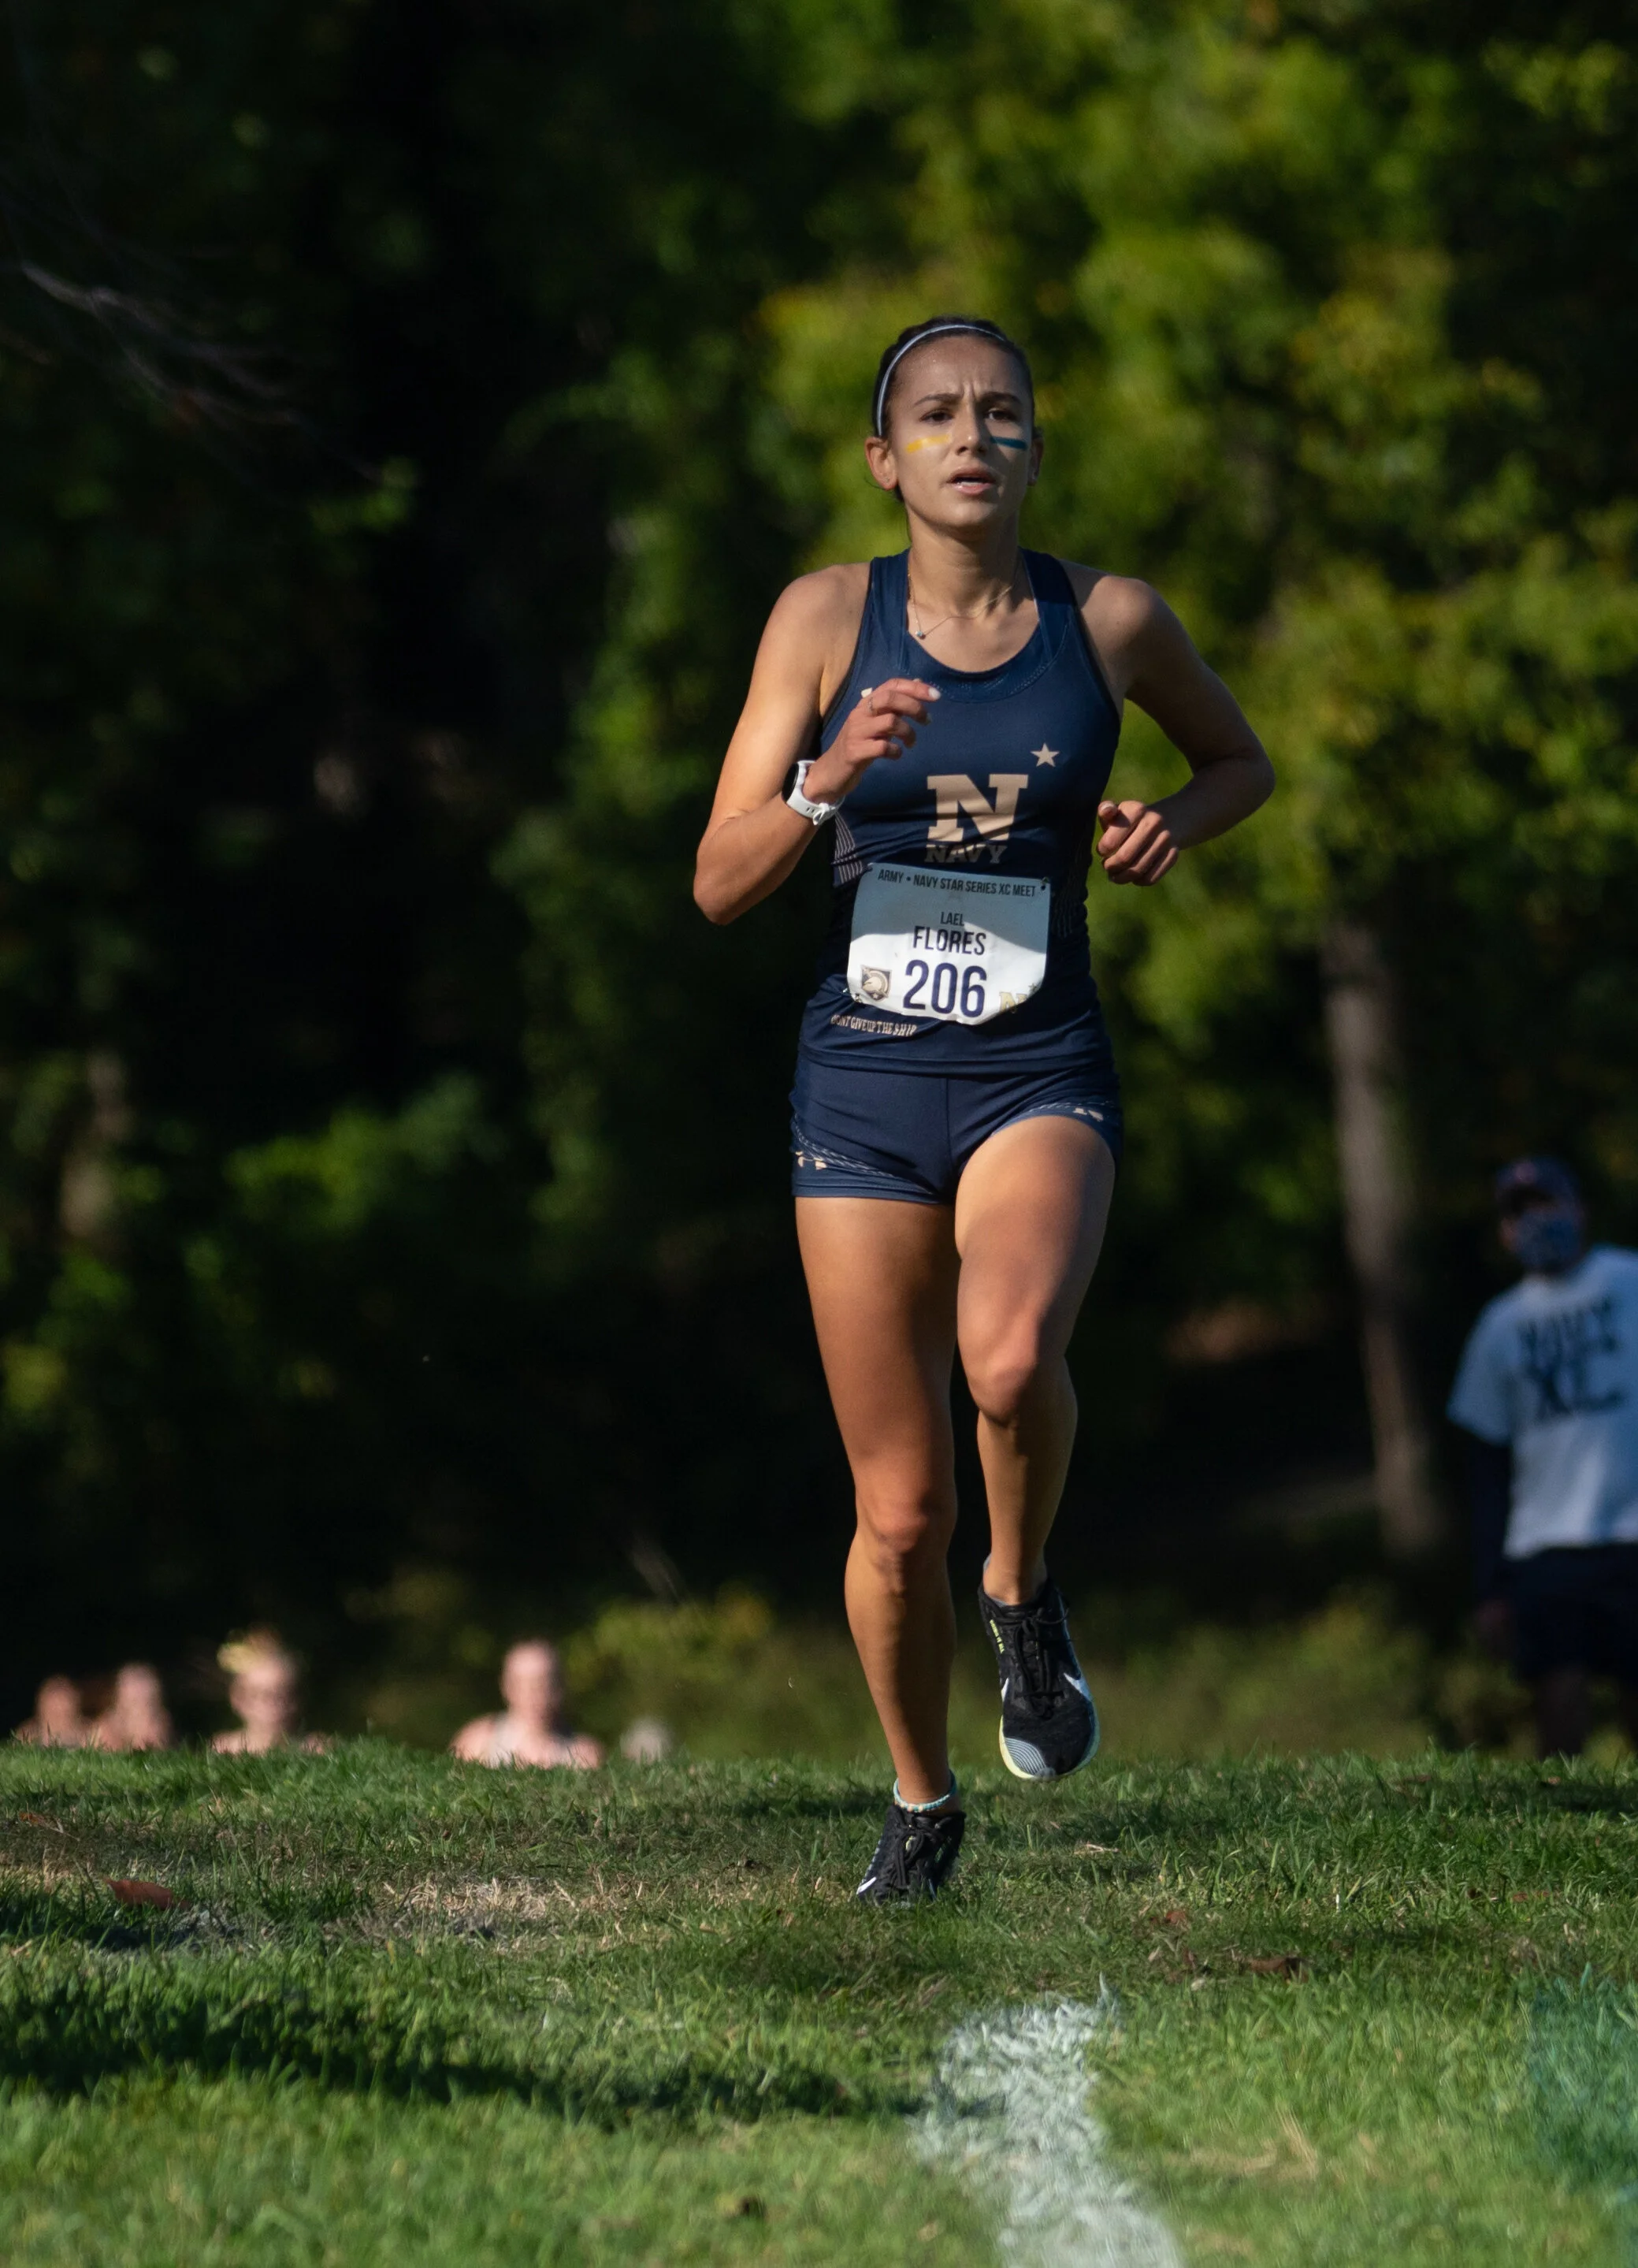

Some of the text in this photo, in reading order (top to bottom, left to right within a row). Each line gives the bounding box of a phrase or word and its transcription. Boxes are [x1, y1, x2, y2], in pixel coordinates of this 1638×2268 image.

[927, 774, 1029, 842] N
[924, 843, 1008, 864] NAVY
[878, 868, 1036, 897] ARMY NAVY STAR SERIES XC MEET
[940, 911, 965, 927] LAEL
[912, 925, 987, 956] FLORES
[903, 959, 988, 1018] 206
[877, 1021, 893, 1035] THE
[893, 1024, 918, 1036] SHIP
